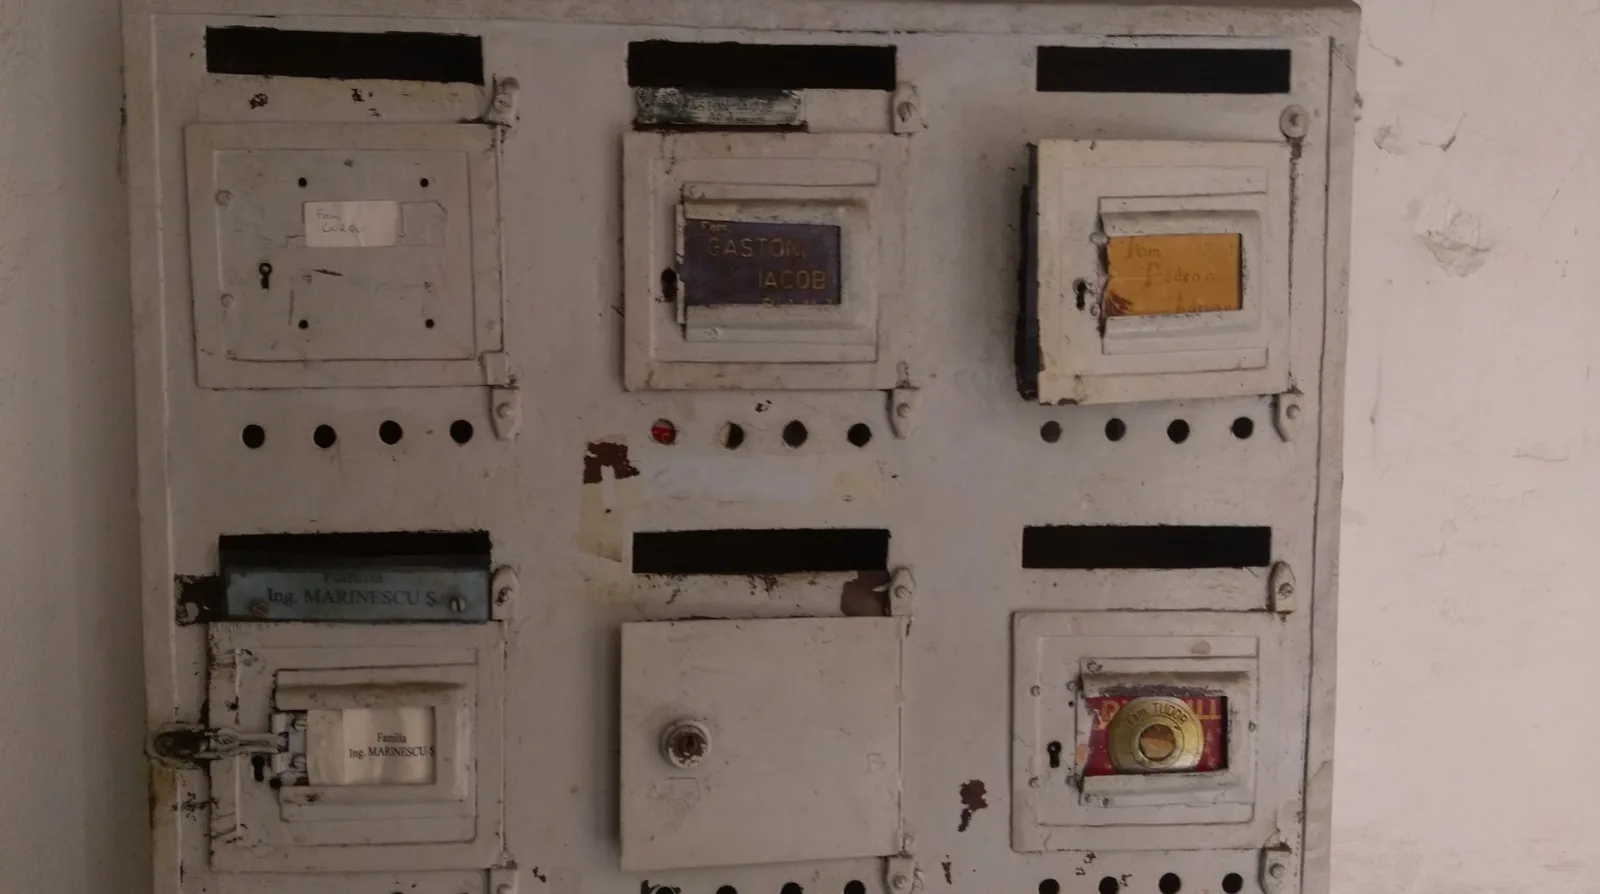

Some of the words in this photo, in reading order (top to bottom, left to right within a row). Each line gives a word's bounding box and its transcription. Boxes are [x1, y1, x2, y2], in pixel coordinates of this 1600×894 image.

[758, 267, 826, 291] IACOB
[267, 587, 299, 606] Ing.
[304, 588, 421, 606] MARINESCU
[1151, 702, 1189, 725] TUDOR
[376, 731, 408, 743] Familia
[348, 748, 367, 760] Ing.
[367, 745, 428, 758] MARINESCU
